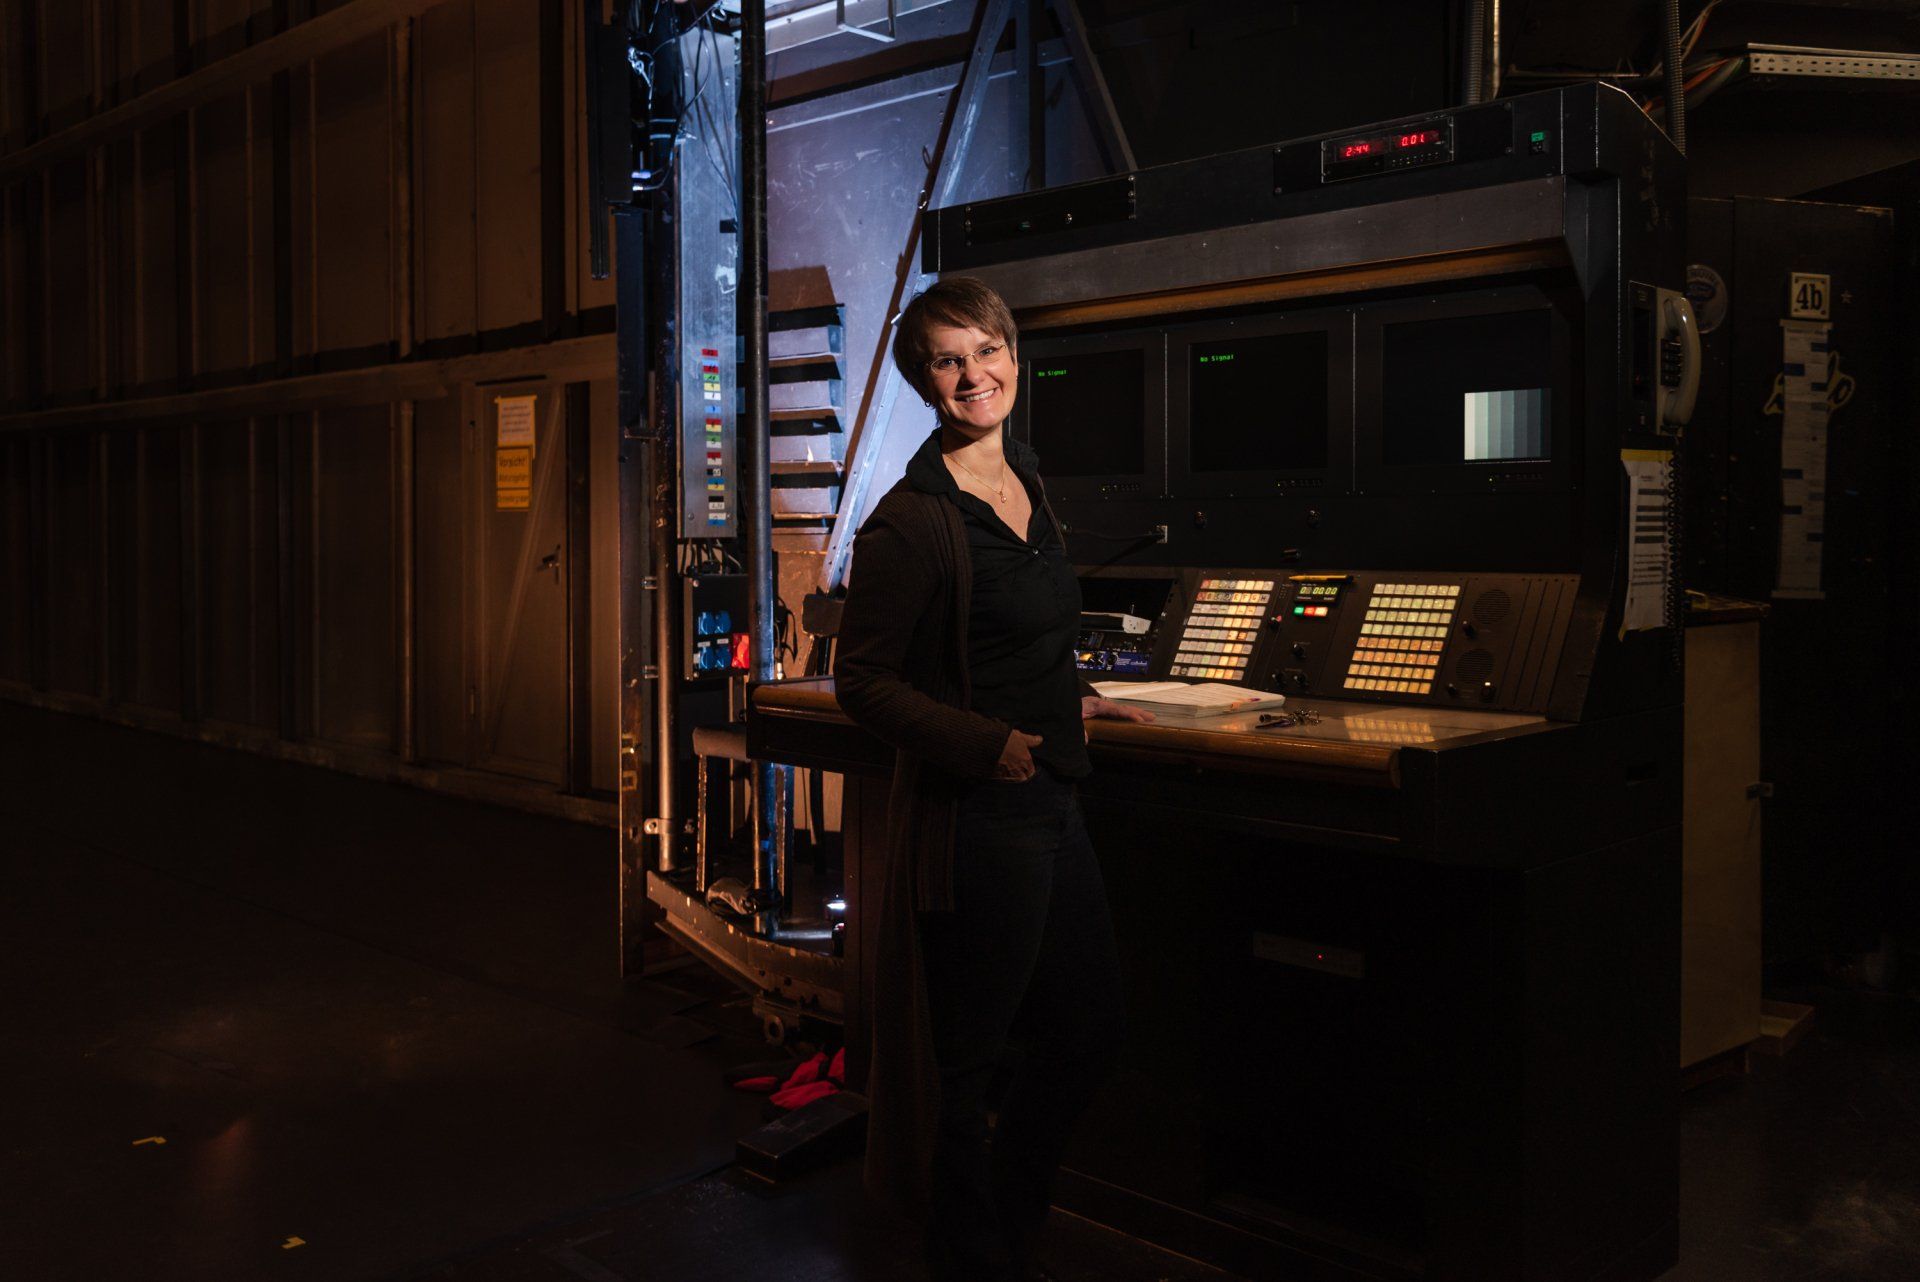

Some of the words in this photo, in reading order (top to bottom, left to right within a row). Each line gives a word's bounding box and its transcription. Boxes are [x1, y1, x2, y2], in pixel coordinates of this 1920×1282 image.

[1346, 144, 1369, 157] 2:44
[1796, 283, 1822, 310] 4b
[1211, 354, 1234, 362] Signal
[1047, 369, 1067, 377] Signal
